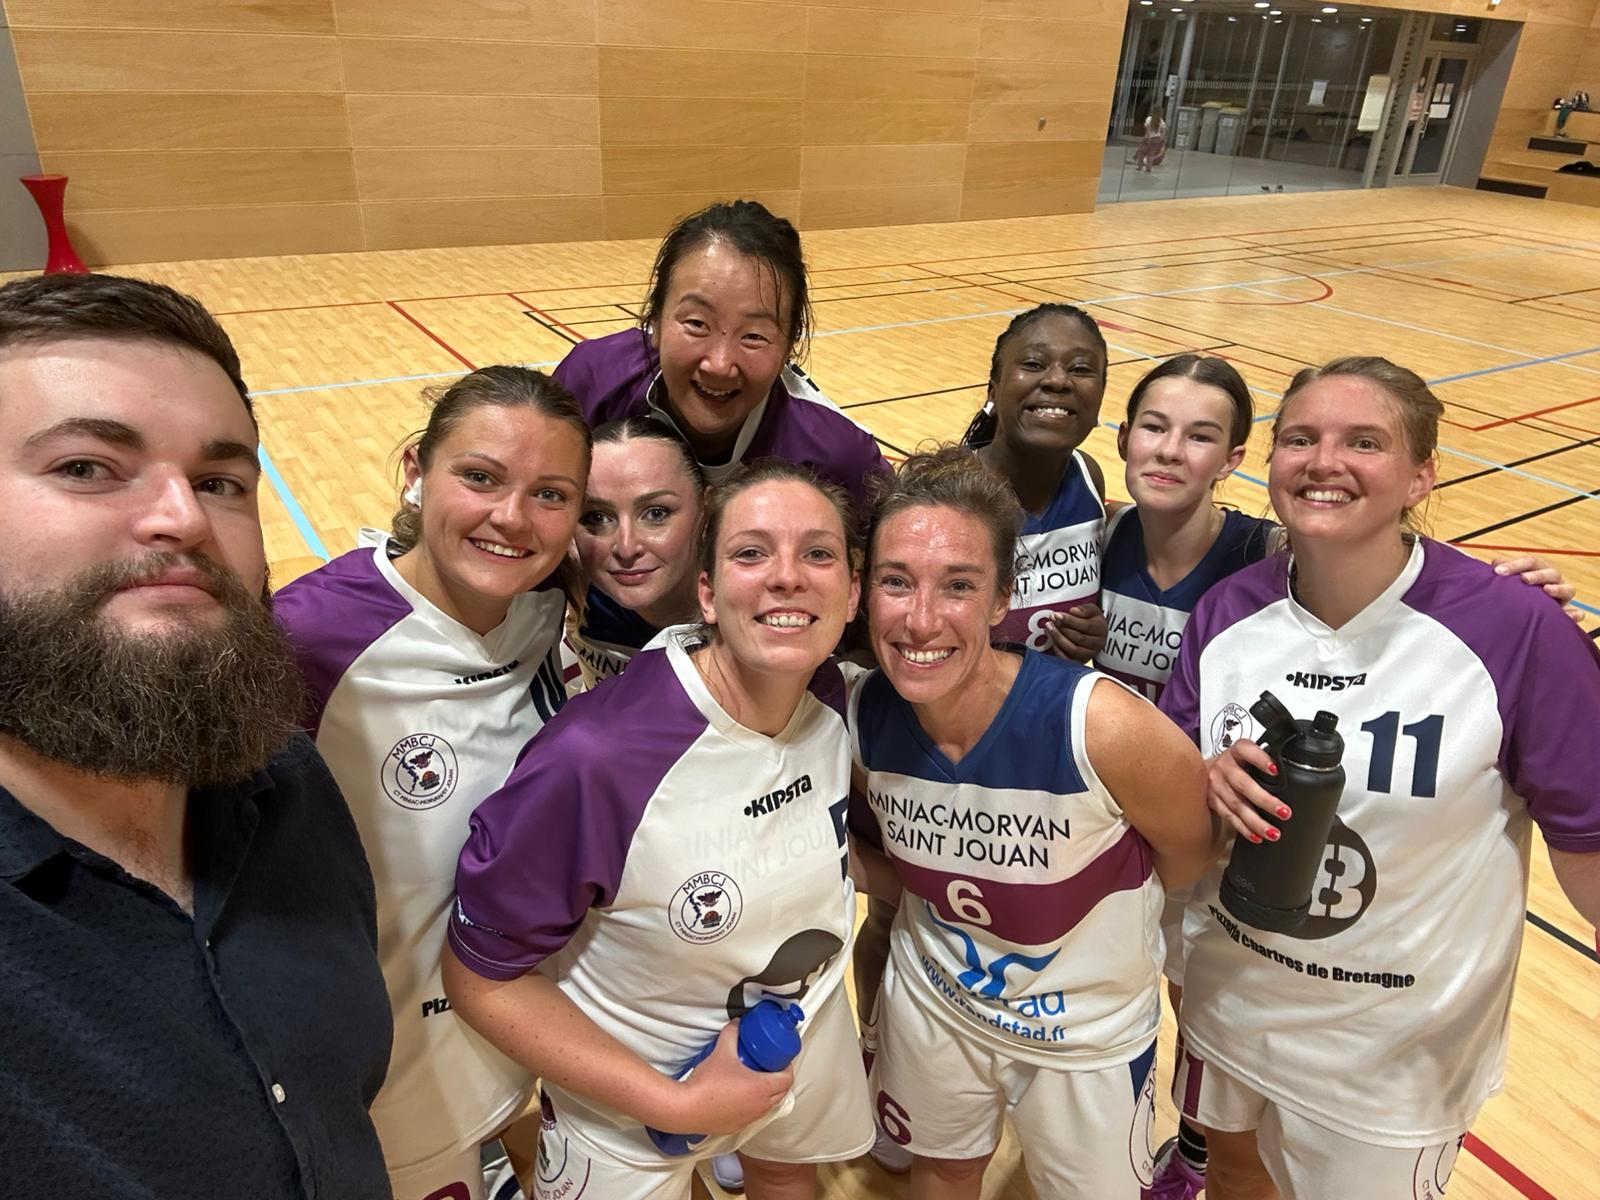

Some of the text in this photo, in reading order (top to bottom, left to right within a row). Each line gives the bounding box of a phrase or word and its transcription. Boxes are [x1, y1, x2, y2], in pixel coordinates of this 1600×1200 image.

[1037, 563, 1098, 593] JOUAN
[1026, 609, 1055, 653] 8
[1105, 639, 1140, 662] INT
[391, 736, 436, 760] MMBCJ
[1360, 710, 1445, 798] 11
[869, 788, 1071, 841] MINIAC-MORVAN
[886, 820, 1049, 870] SAINT JOUAN
[683, 873, 727, 896] MMBCJ
[946, 879, 993, 927] 6
[1308, 843, 1366, 919] B
[1241, 932, 1305, 973] Chartres
[1306, 961, 1329, 980] de
[1331, 966, 1416, 988] Bretagne
[876, 1089, 913, 1146] 6
